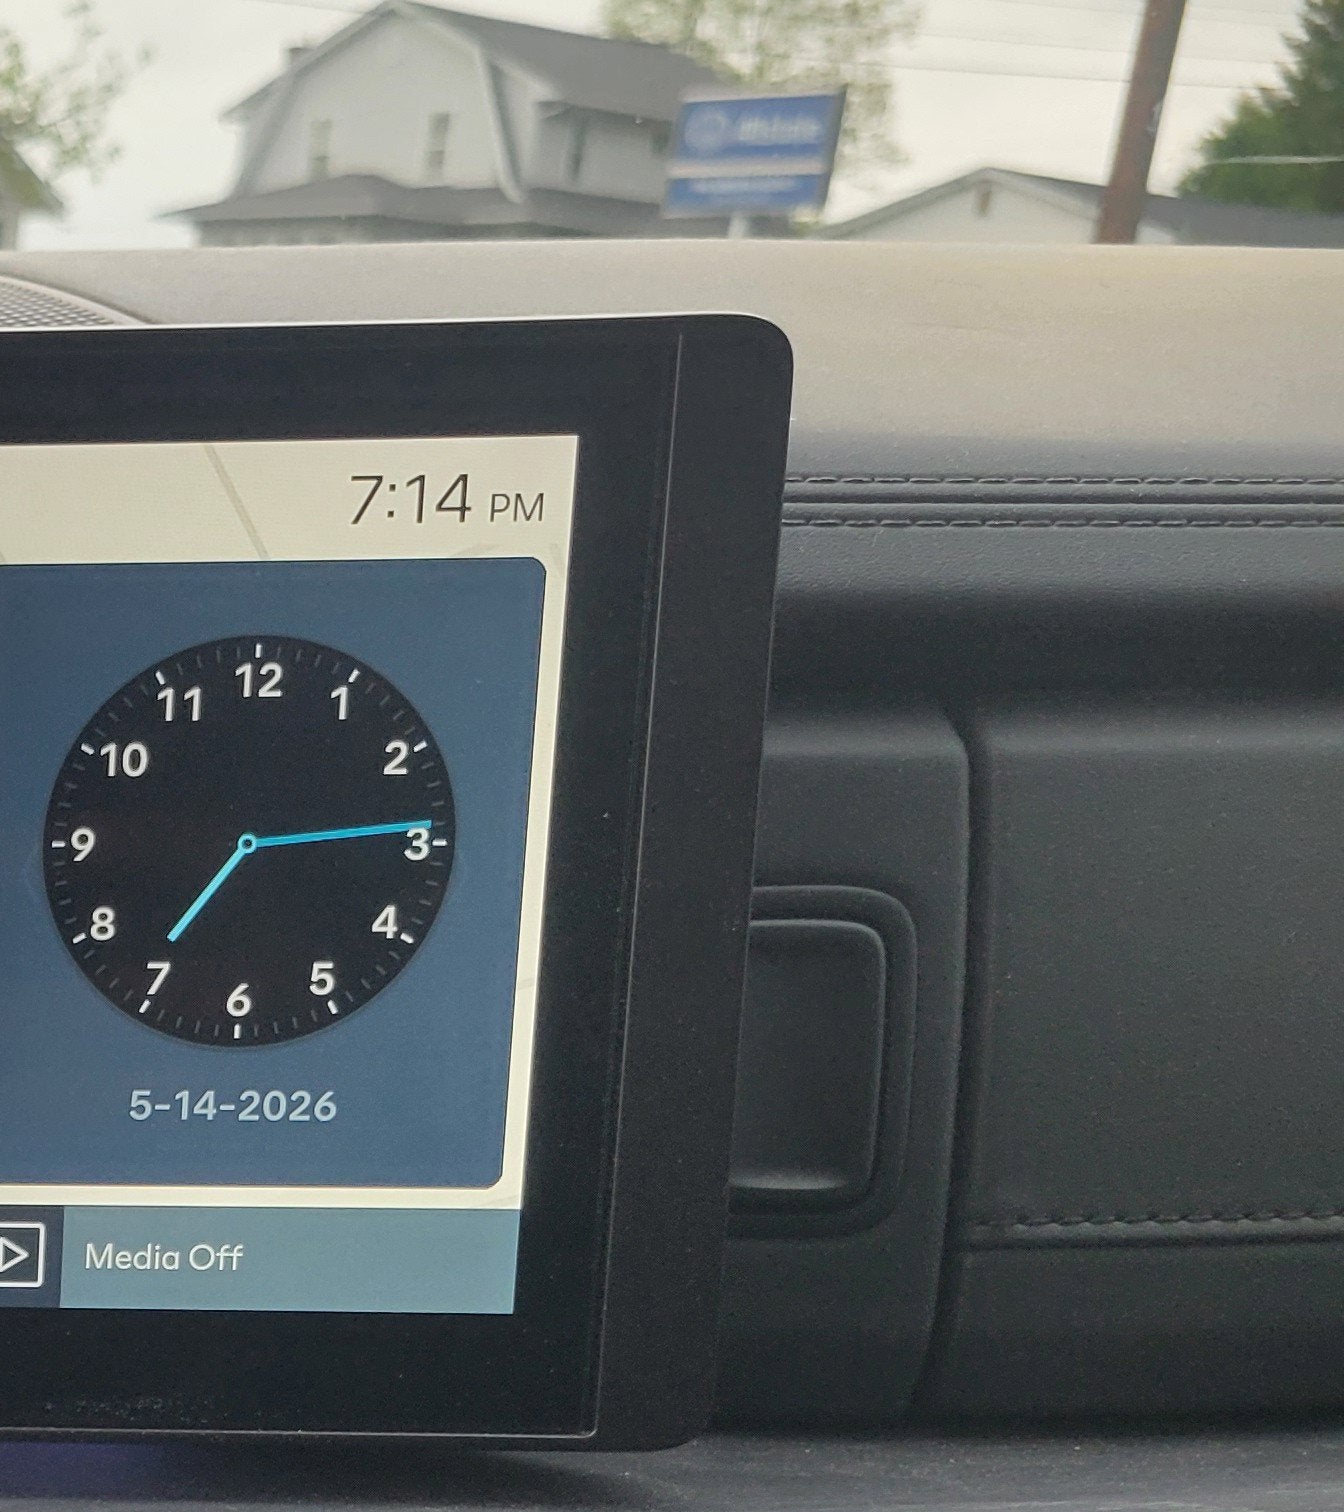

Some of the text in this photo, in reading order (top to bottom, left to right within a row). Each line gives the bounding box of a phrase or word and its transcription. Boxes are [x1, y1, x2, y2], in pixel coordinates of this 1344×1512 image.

[350, 473, 546, 525] 7:14 PM
[234, 662, 283, 698] 12
[156, 686, 202, 722] 11
[330, 685, 349, 720] 1
[99, 741, 150, 778] 10
[382, 740, 409, 775] 2
[69, 826, 97, 862] 9
[403, 828, 431, 862] 3
[89, 906, 117, 941] 8
[371, 904, 399, 940] 4
[145, 961, 173, 996] 7
[308, 961, 336, 996] 5
[225, 982, 253, 1018] 6
[128, 1089, 338, 1123] 5-14-2026
[84, 1242, 244, 1272] Media Off
